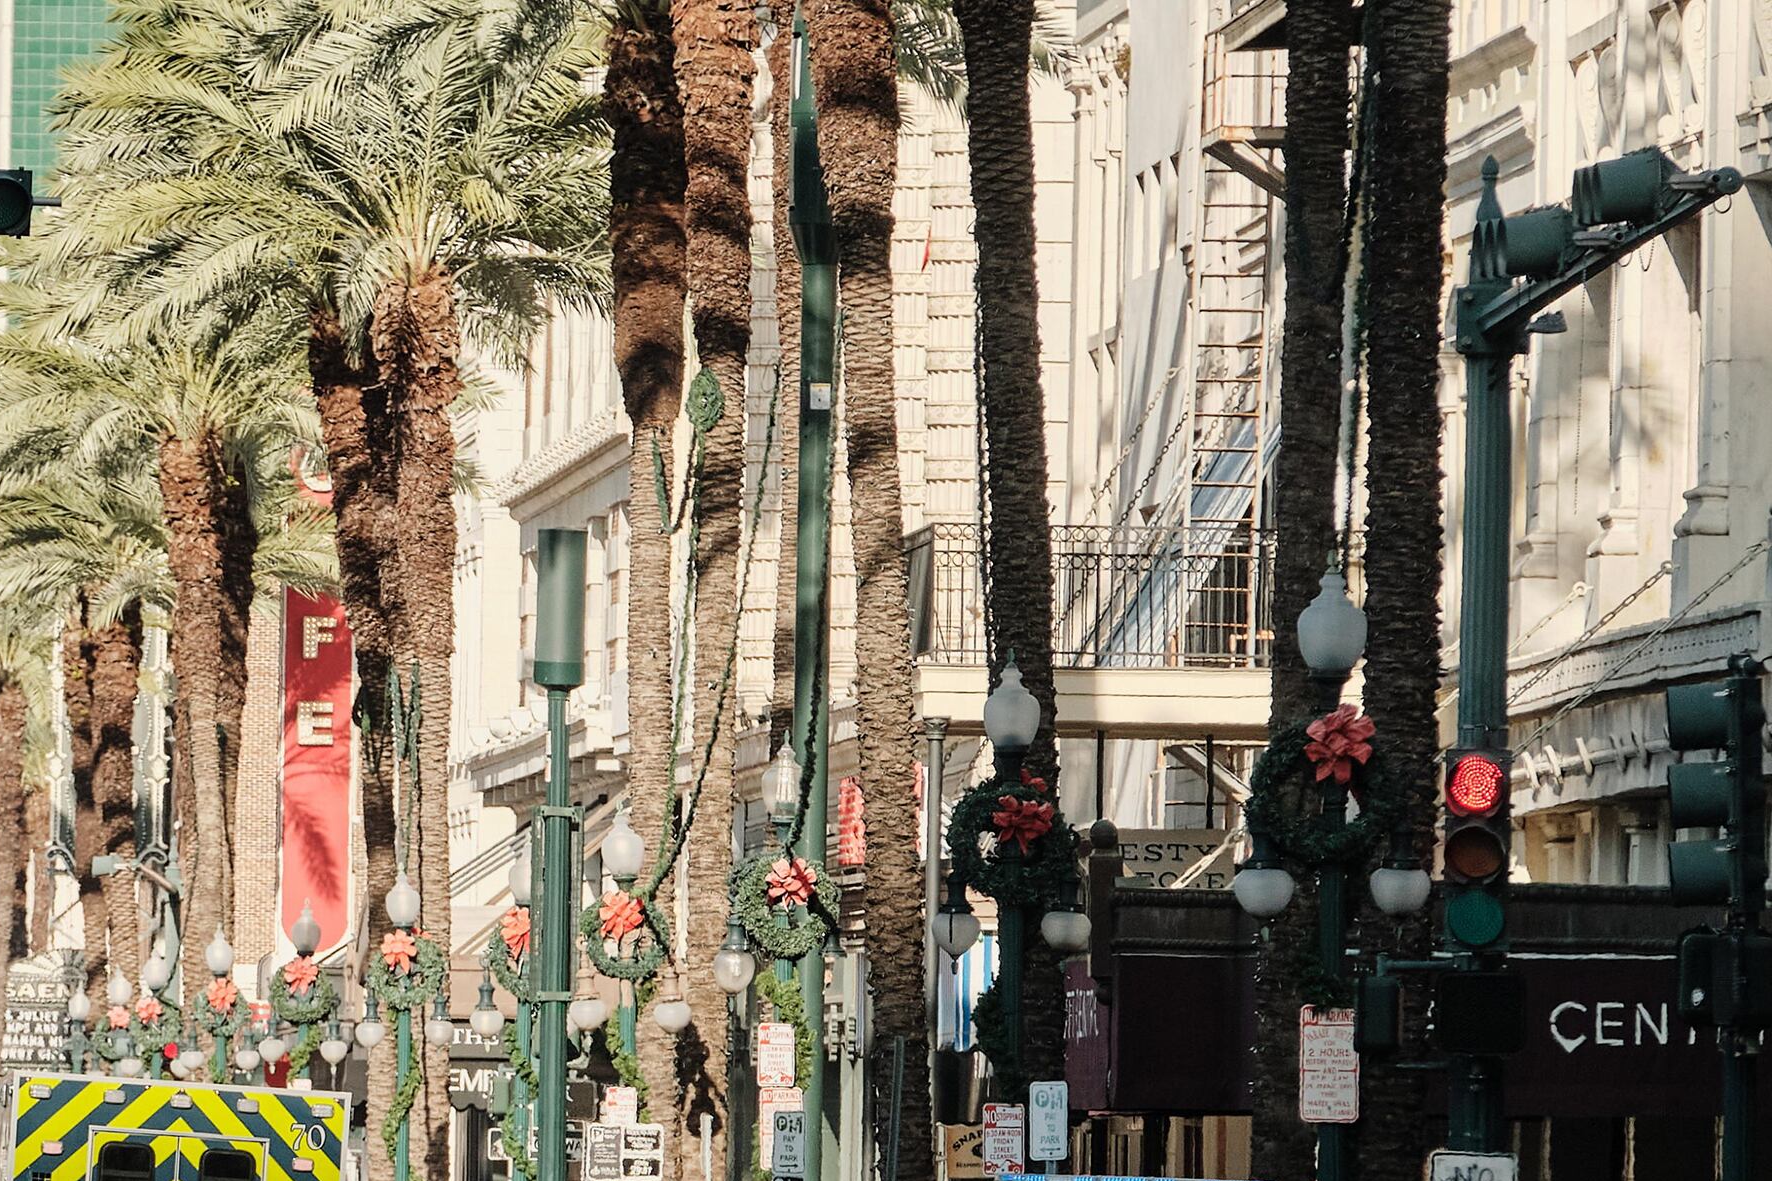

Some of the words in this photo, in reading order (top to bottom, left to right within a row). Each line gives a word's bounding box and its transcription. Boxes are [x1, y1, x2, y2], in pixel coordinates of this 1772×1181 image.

[5, 983, 70, 998] SAEN
[1549, 1001, 1696, 1053] CEN
[1308, 1049, 1315, 1057] 2
[1320, 1048, 1351, 1057] HOURS
[985, 1110, 996, 1124] NO
[996, 1112, 1023, 1121] STOPPING
[291, 1123, 327, 1151] 70
[1039, 1135, 1060, 1144] PARK
